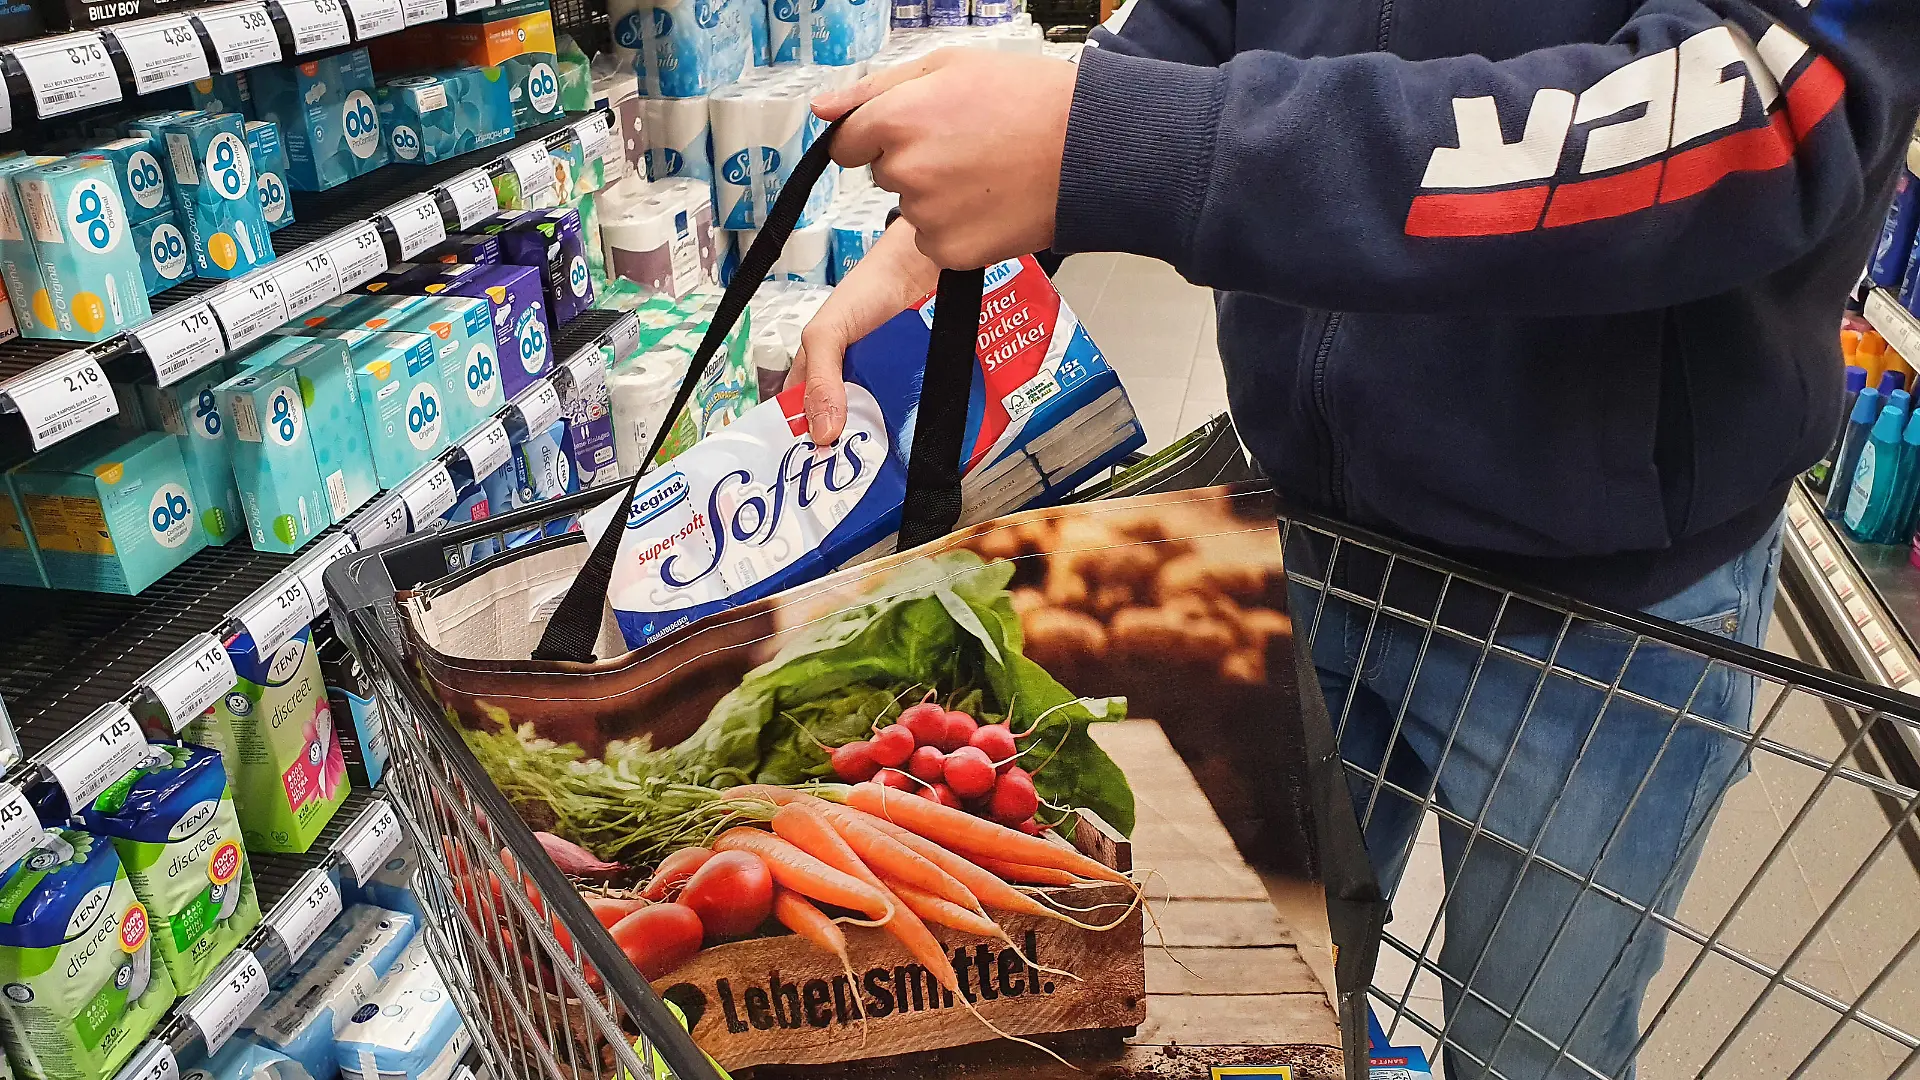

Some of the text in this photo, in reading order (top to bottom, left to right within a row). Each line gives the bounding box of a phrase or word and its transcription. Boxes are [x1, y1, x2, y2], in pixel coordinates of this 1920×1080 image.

[88, 1, 140, 21] BILLY BOY
[240, 12, 266, 31] 3,89
[163, 26, 192, 47] 4,86
[66, 44, 101, 65] 8,76
[531, 149, 546, 164] 3,52
[474, 177, 489, 193] 3,52
[418, 204, 436, 221] 3,52
[355, 231, 376, 249] 3,52
[305, 254, 328, 272] 1,76
[249, 280, 274, 300] 1,76
[979, 289, 1017, 326] ofter
[181, 312, 208, 333] 1,76
[977, 307, 1030, 350] Dicker
[984, 321, 1046, 372] Stärker
[586, 352, 600, 367] 3,52
[1059, 359, 1080, 374] 15x
[63, 367, 98, 392] 2,18
[540, 388, 554, 404] 3,52
[487, 427, 504, 445] 3,52
[541, 445, 555, 491] discreet
[428, 471, 447, 490] 3,52
[627, 479, 685, 520] Regina
[660, 430, 872, 590] Softis
[384, 508, 402, 530] 3,52
[638, 512, 706, 566] super-soft
[277, 584, 302, 609] 2,05
[195, 648, 222, 673] 1,16
[273, 646, 299, 676] TENA
[271, 677, 313, 729] discreet
[100, 717, 131, 746] 1,45
[291, 776, 308, 797] ULTRA
[177, 804, 210, 833] TENA
[371, 813, 392, 838] 3,36
[168, 826, 221, 878] discreet
[214, 847, 234, 869] 100%
[217, 855, 235, 876] GELD
[307, 883, 329, 909] 3,36
[72, 890, 103, 929] TENA
[123, 910, 141, 934] 100%
[126, 919, 144, 943] GELD
[185, 917, 201, 935] MINI
[187, 923, 204, 940] PLUS
[67, 911, 120, 979] discreet
[191, 938, 207, 957] x16
[230, 964, 257, 993] 3,36
[91, 1009, 109, 1031] MINI
[101, 1027, 116, 1051] x20
